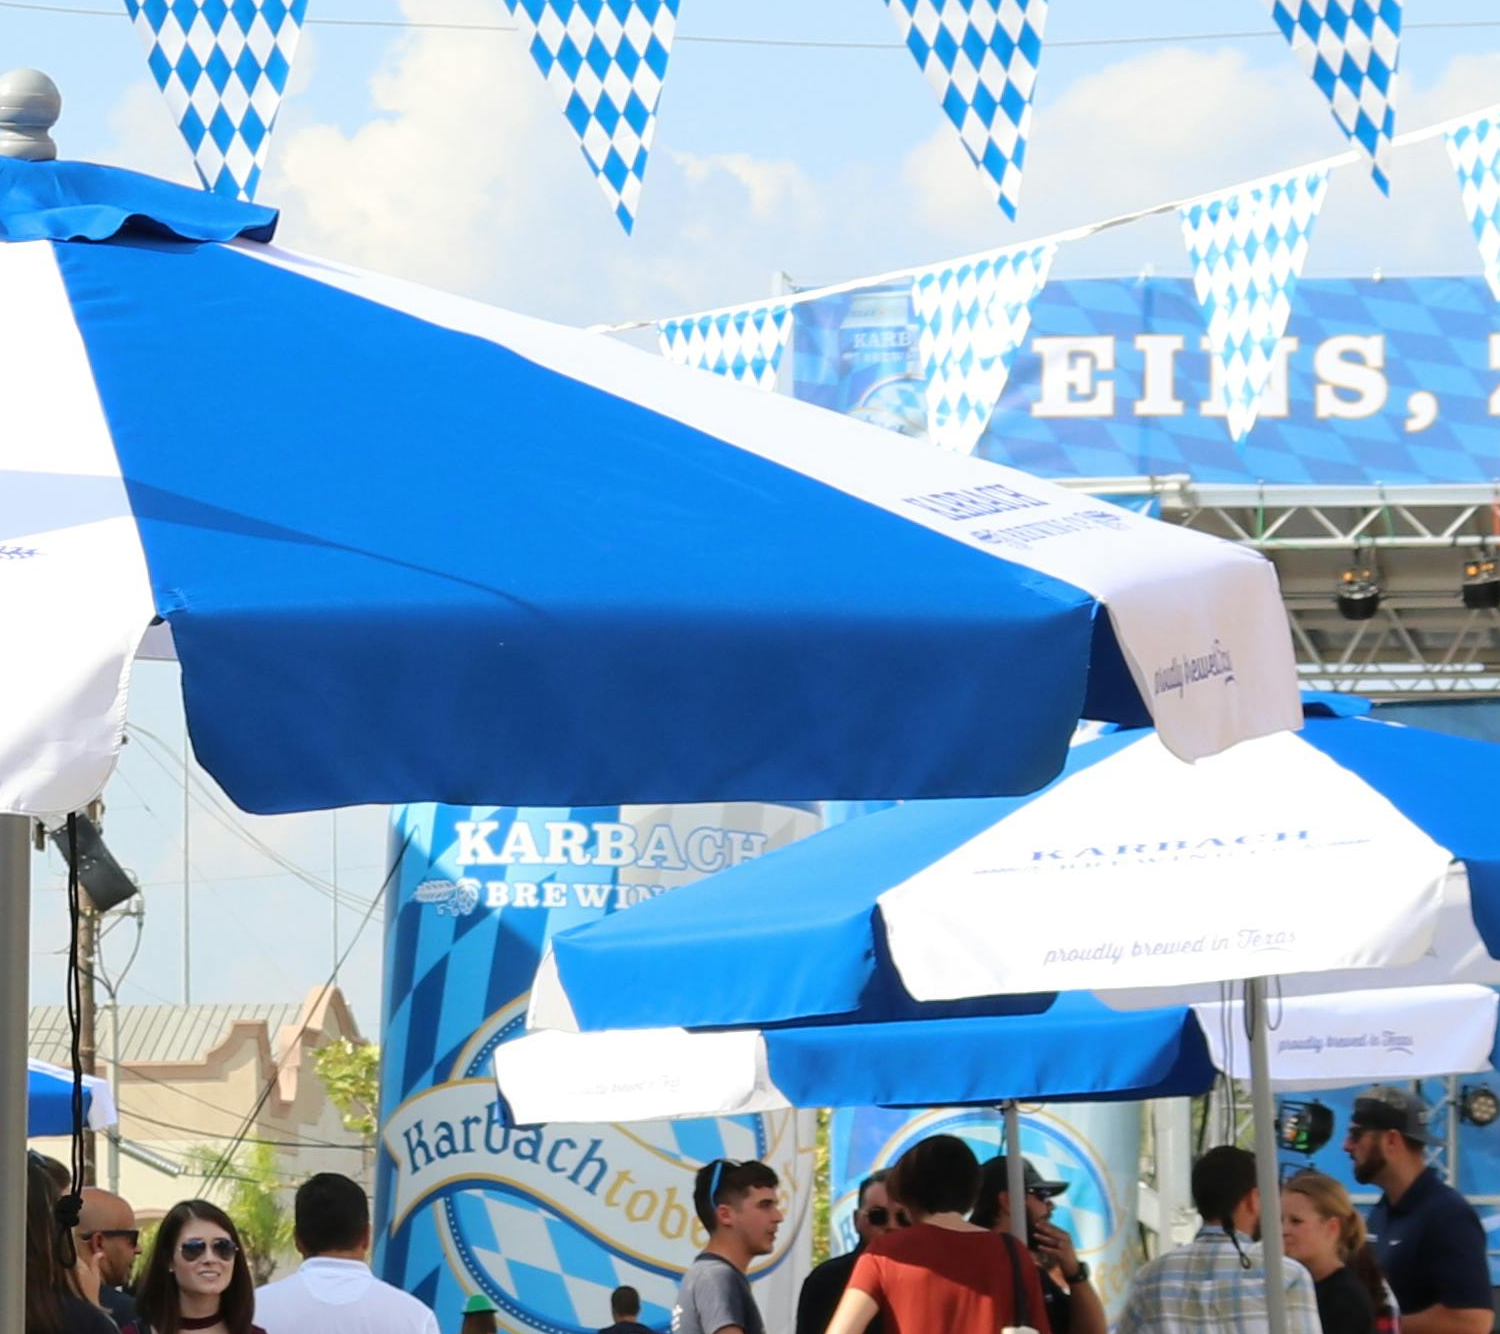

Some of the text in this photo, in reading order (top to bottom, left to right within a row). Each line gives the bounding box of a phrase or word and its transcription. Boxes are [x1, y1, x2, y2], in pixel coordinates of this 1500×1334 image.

[853, 330, 913, 349] KARB
[454, 820, 767, 874] KARBACH
[1031, 830, 1311, 862] KARBACH
[485, 881, 678, 909] BREWIN
[1043, 927, 1297, 966] proudly brewed in Texas
